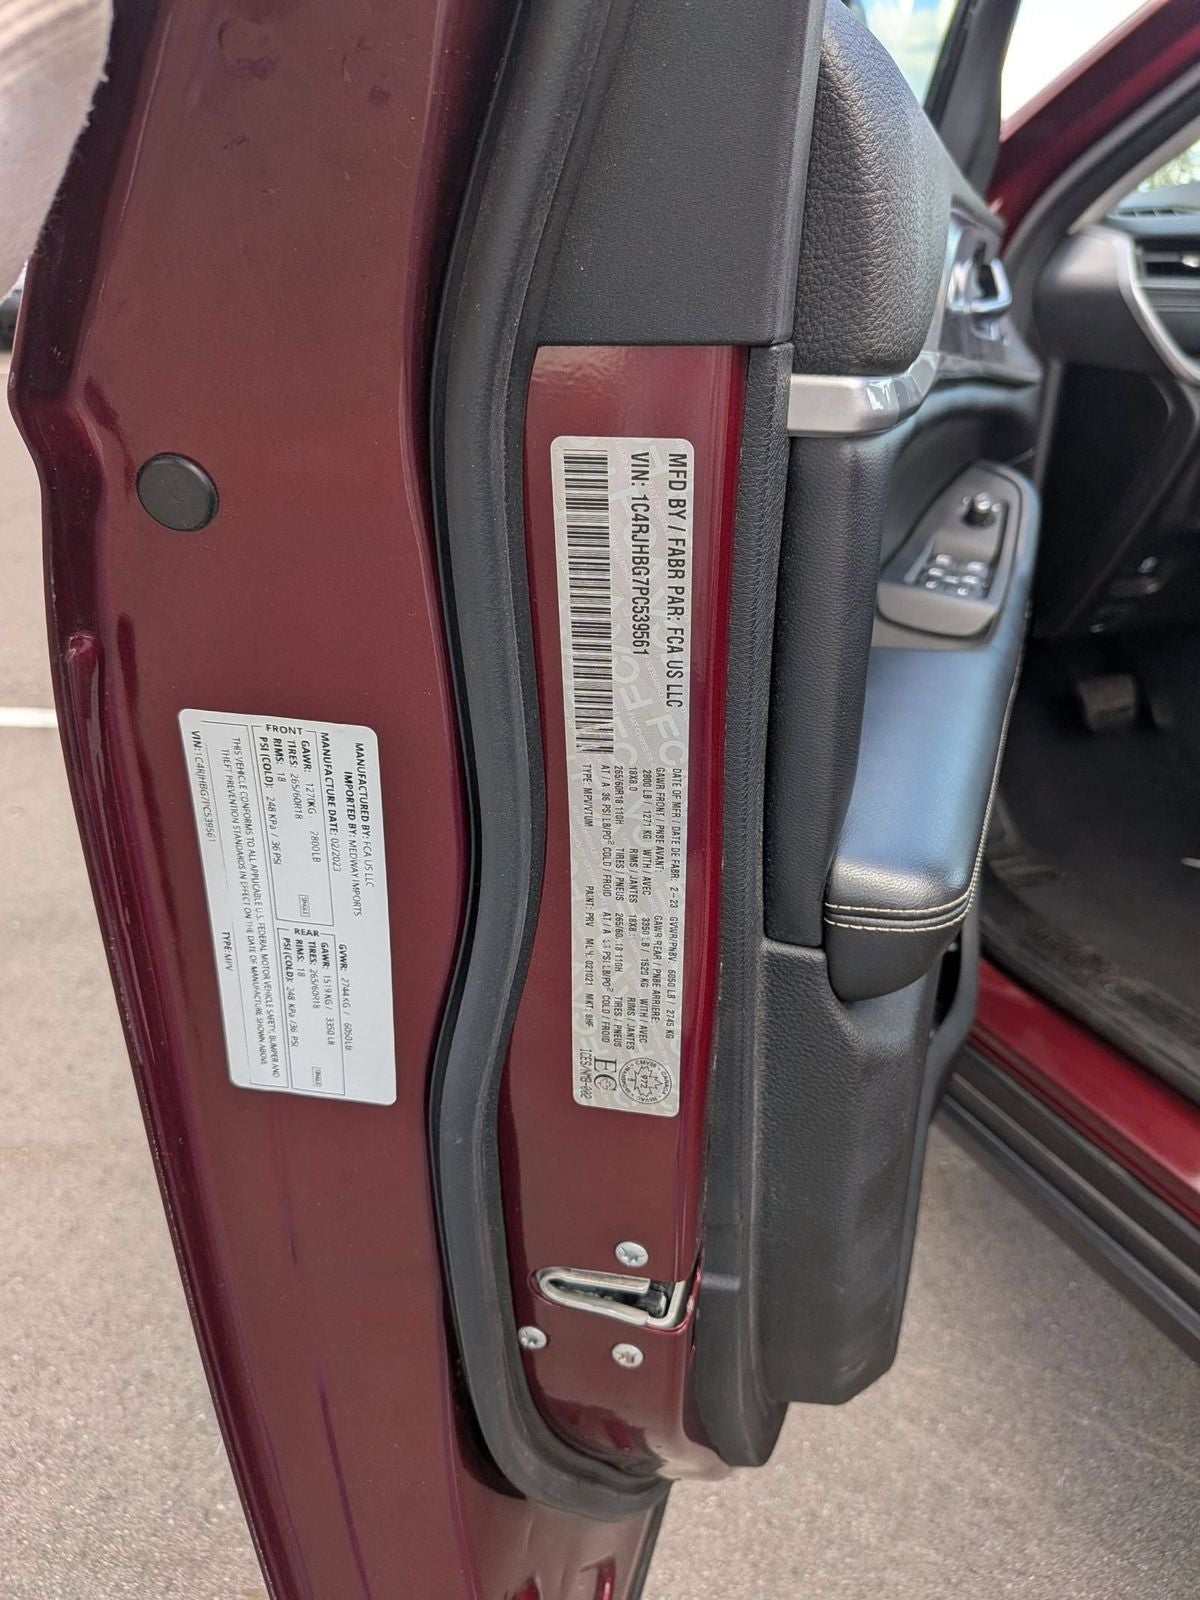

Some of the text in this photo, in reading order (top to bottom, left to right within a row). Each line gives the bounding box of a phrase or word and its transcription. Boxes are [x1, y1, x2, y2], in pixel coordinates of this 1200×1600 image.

[630, 451, 649, 486] VIN:
[631, 494, 649, 655] 1C4RJHBG7PC539561
[666, 454, 686, 707] MFD BY FABR PAR: FCA US LLC
[265, 724, 302, 734] FRONT
[191, 730, 202, 751] VIN:
[231, 737, 242, 754] THIS
[259, 736, 268, 750] PSI
[221, 749, 232, 772] THEFT
[273, 738, 285, 782] RIMS: 18
[301, 740, 311, 772] GAWR:
[235, 756, 246, 789] VEHICLE
[259, 753, 273, 788] (COLD):
[582, 764, 591, 784] TYPE:
[600, 764, 610, 774] AT
[642, 769, 651, 787] 2800
[671, 768, 681, 787] DATE
[287, 740, 303, 819] TIRES: 265/60R18
[614, 765, 623, 803] 265/60R18
[225, 774, 239, 823] PREVENTION
[266, 796, 276, 811] 248
[320, 732, 340, 871] MANUFACTURE DATE: 02/2023
[601, 792, 610, 801] 36
[671, 789, 681, 799] OF
[239, 791, 252, 835] CONFORMS
[355, 742, 374, 887] MANUFACTURED BY: FCA US LLC
[601, 804, 610, 815] PSI
[642, 810, 651, 826] 1271
[671, 801, 680, 817] MFR
[654, 767, 665, 872] GAWR FRONT PNBE AVANT:
[245, 837, 254, 847] TO
[344, 771, 361, 916] IMPORTED BY: MEDWAY IMPORTS
[628, 766, 637, 903] 18X8.0 RIMS JANTES
[642, 830, 651, 839] KG
[670, 826, 680, 845] DATE
[232, 824, 245, 869] STANDARDS
[247, 849, 256, 861] ALL
[602, 846, 611, 866] COLD
[670, 847, 679, 856] DE
[615, 848, 624, 868] TIRES
[642, 848, 651, 868] WITH
[670, 859, 679, 881] FABR:
[602, 874, 611, 896] FROID
[615, 876, 624, 901] PNEUS
[642, 876, 651, 895] AVEC
[243, 907, 252, 918] ON
[584, 911, 594, 927] PRV
[602, 911, 610, 920] AT
[221, 930, 232, 952] TYPE:
[256, 922, 267, 951] FEDERAL
[294, 928, 319, 936] REAR
[247, 935, 256, 952] DATE
[307, 941, 316, 965] TIRES:
[652, 940, 661, 960] REAR
[294, 939, 305, 977] RIMS: 18
[320, 941, 329, 969] GAWR:
[338, 943, 347, 971] GVWR:
[260, 953, 270, 980] MOTOR
[584, 960, 593, 985] 021021
[640, 958, 648, 975] 1520
[640, 977, 648, 987] KG
[652, 968, 660, 987] PNBE
[667, 969, 675, 987] 6050
[250, 965, 263, 1015] MANUFACTURE
[263, 981, 273, 1008] VEHICLE
[666, 989, 675, 999] LB
[584, 993, 593, 1011] MKT:
[601, 995, 610, 1013] COLD
[613, 996, 622, 1016] TIRES
[639, 997, 648, 1017] WITH
[651, 989, 660, 1023] ARRIERE:
[626, 997, 635, 1049] RIMS JANTES
[666, 1009, 674, 1027] 2745
[601, 1021, 610, 1043] FROID
[613, 1024, 622, 1047] PNEUS
[639, 1024, 647, 1043] AVEC
[665, 1029, 673, 1039] KG
[268, 1034, 278, 1062] BUMPER
